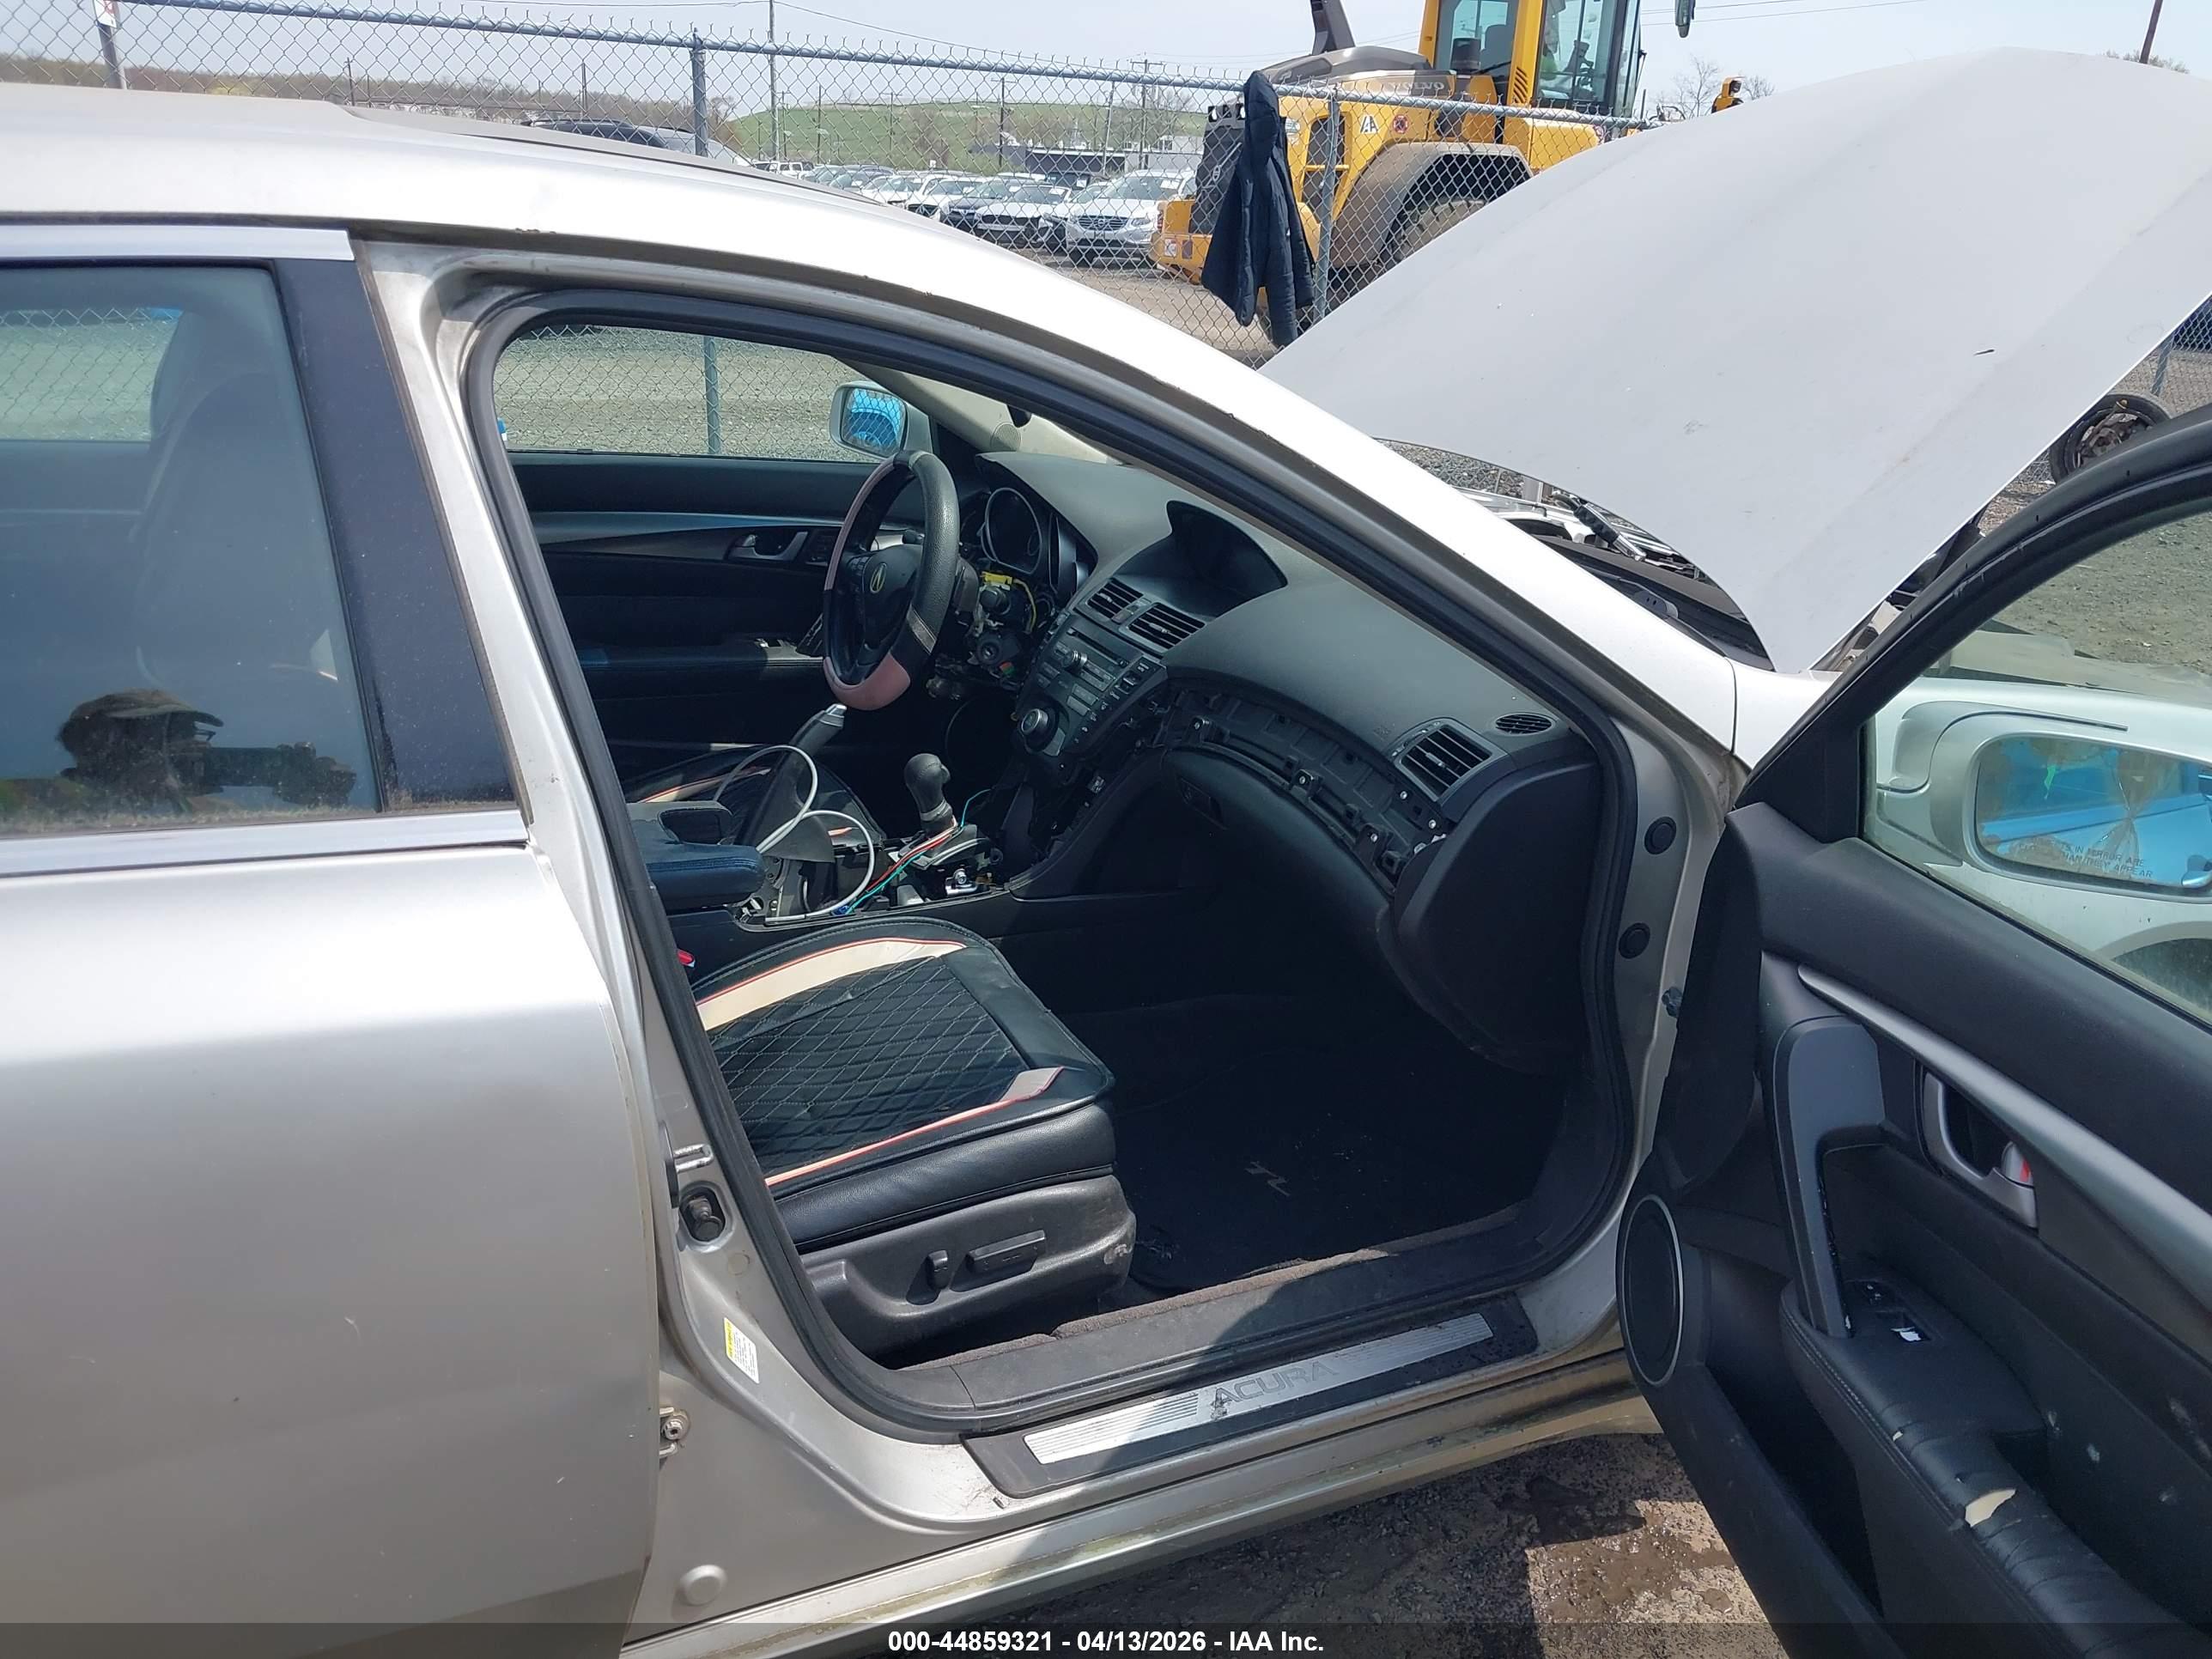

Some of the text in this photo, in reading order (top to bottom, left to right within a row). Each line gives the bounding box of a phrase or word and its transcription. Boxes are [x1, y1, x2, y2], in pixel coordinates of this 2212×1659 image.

[2075, 844, 2084, 854] IN
[2125, 856, 2146, 867] ARE
[2114, 863, 2154, 878] APPEAR
[1214, 1360, 1340, 1407] ACURA
